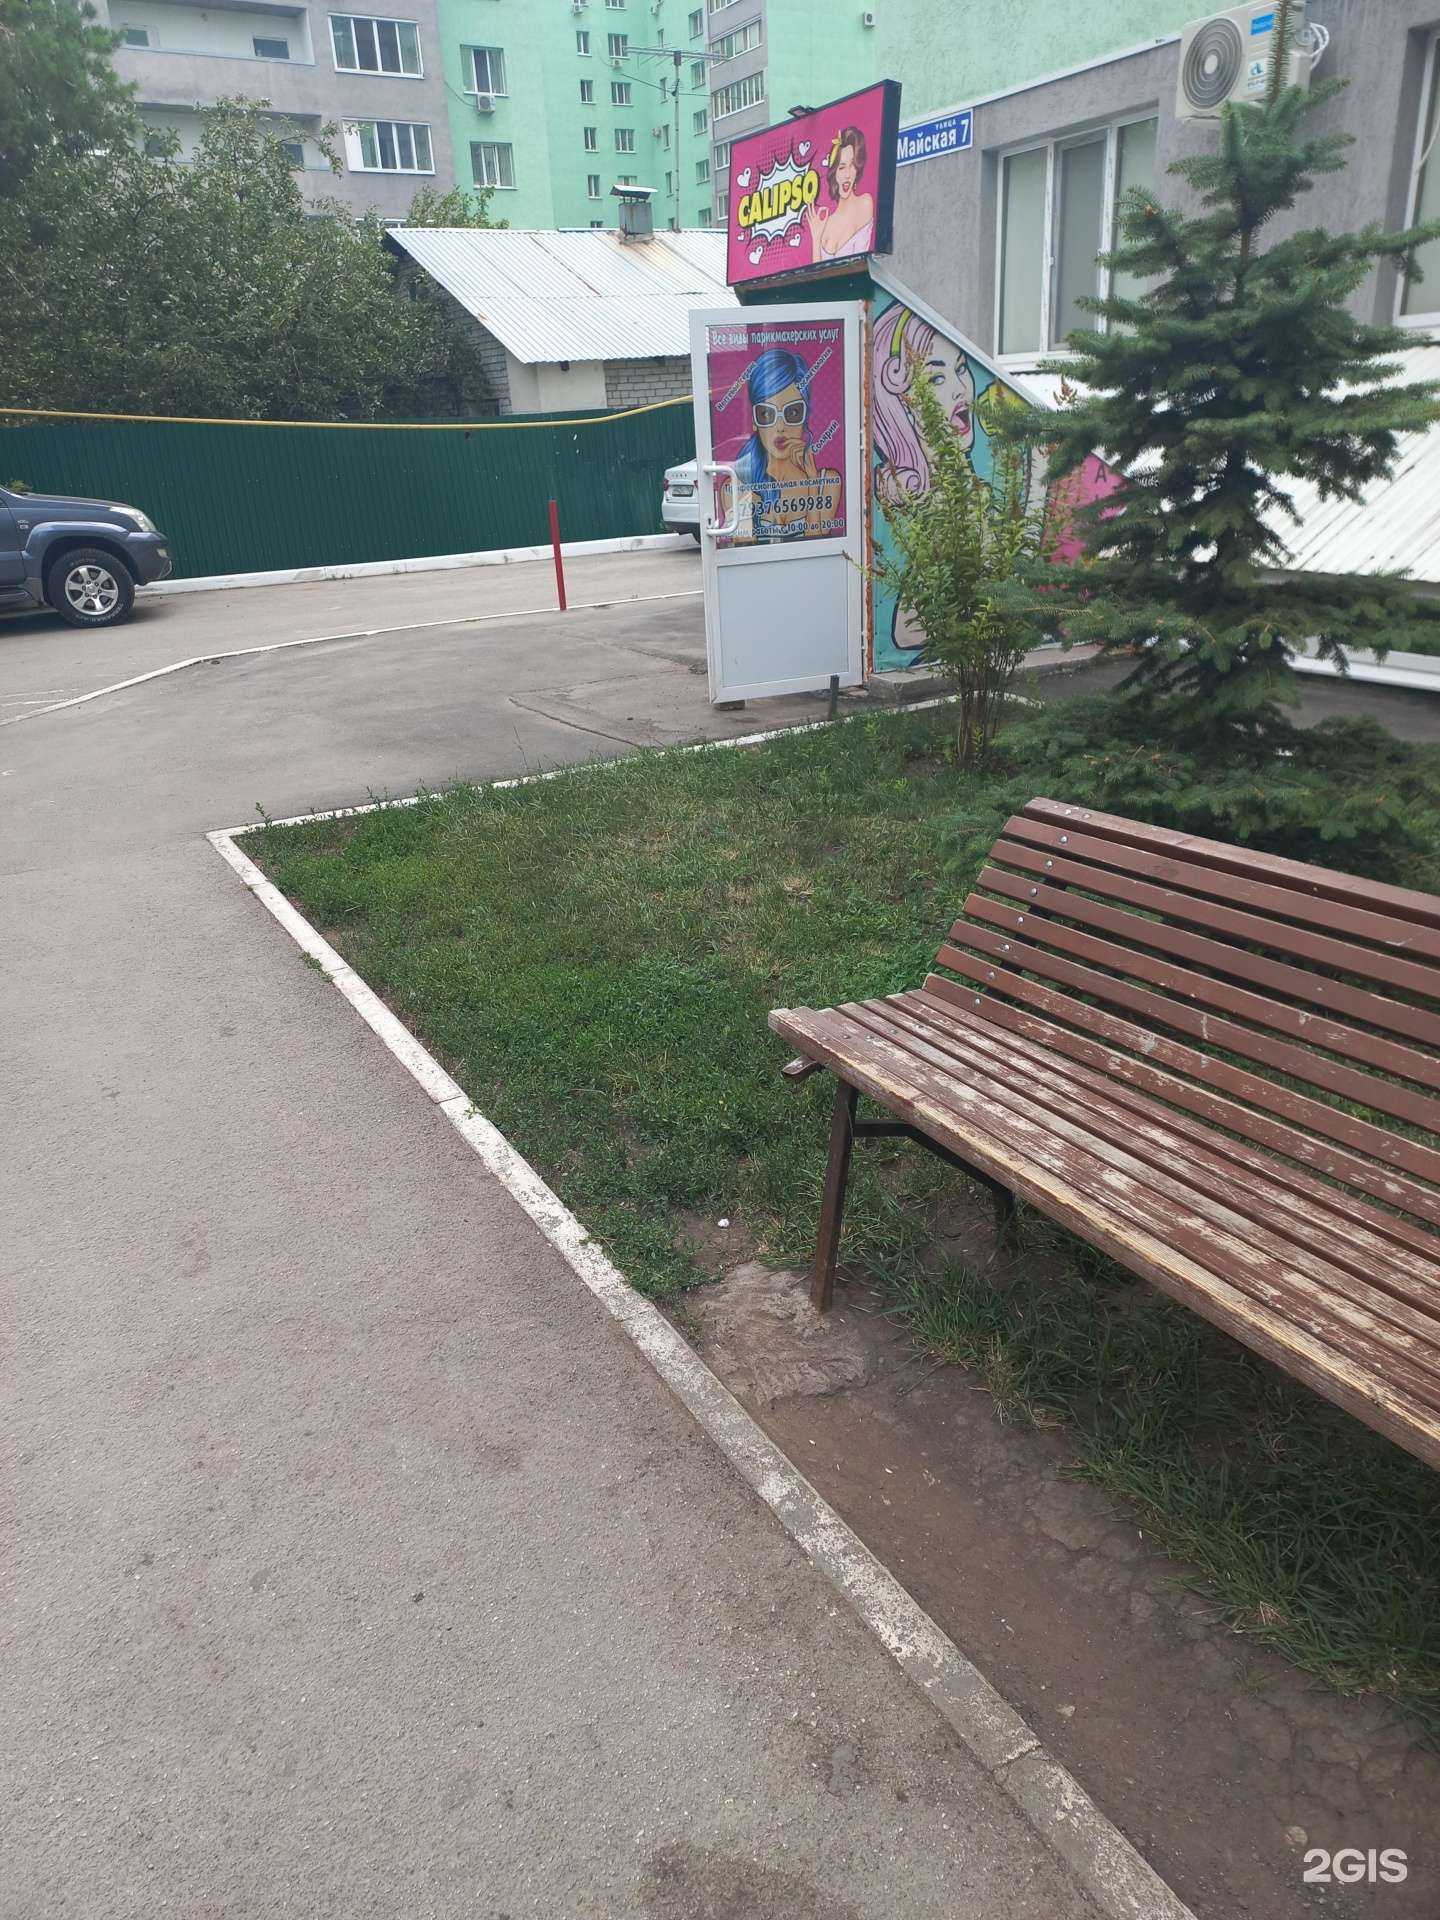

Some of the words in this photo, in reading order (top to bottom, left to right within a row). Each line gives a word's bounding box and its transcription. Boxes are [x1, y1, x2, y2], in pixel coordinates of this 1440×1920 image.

[897, 128, 957, 160] Майская
[961, 118, 969, 143] 7
[738, 169, 819, 228] CALIPSO
[751, 328, 817, 348] парикмахерских
[818, 327, 840, 344] услуг
[799, 477, 840, 488] косметика
[788, 521, 808, 532] 10:00
[810, 523, 819, 531] до
[821, 518, 845, 530] 20:00
